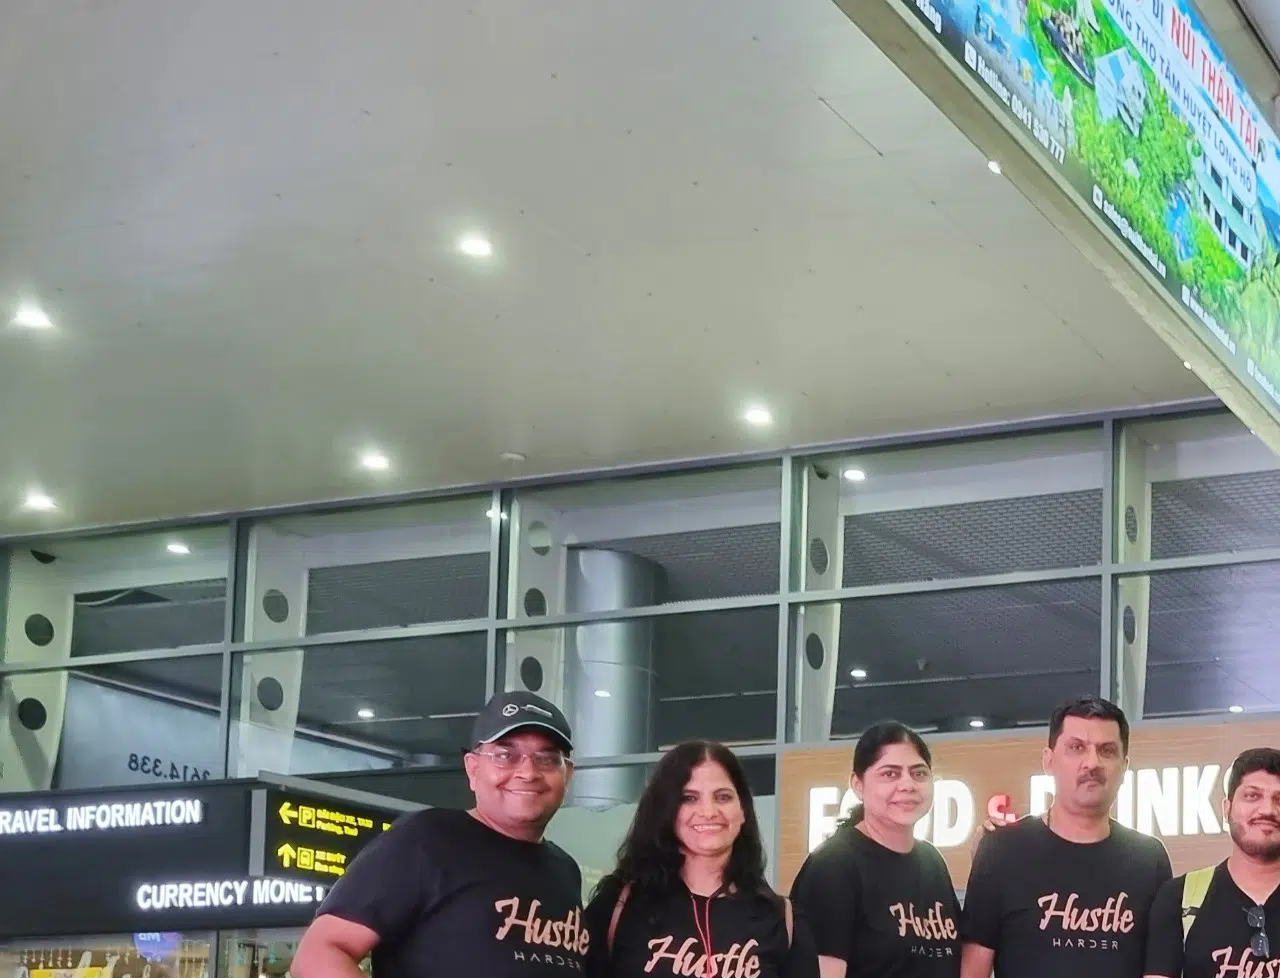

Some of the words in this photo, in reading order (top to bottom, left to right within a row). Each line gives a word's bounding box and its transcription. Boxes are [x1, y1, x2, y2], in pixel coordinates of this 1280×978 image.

[66, 799, 201, 831] INFORMATION
[137, 880, 248, 909] CURRENCY
[494, 896, 590, 956] Hustle
[1037, 891, 1135, 934] Hustle
[1052, 938, 1119, 951] HARDER
